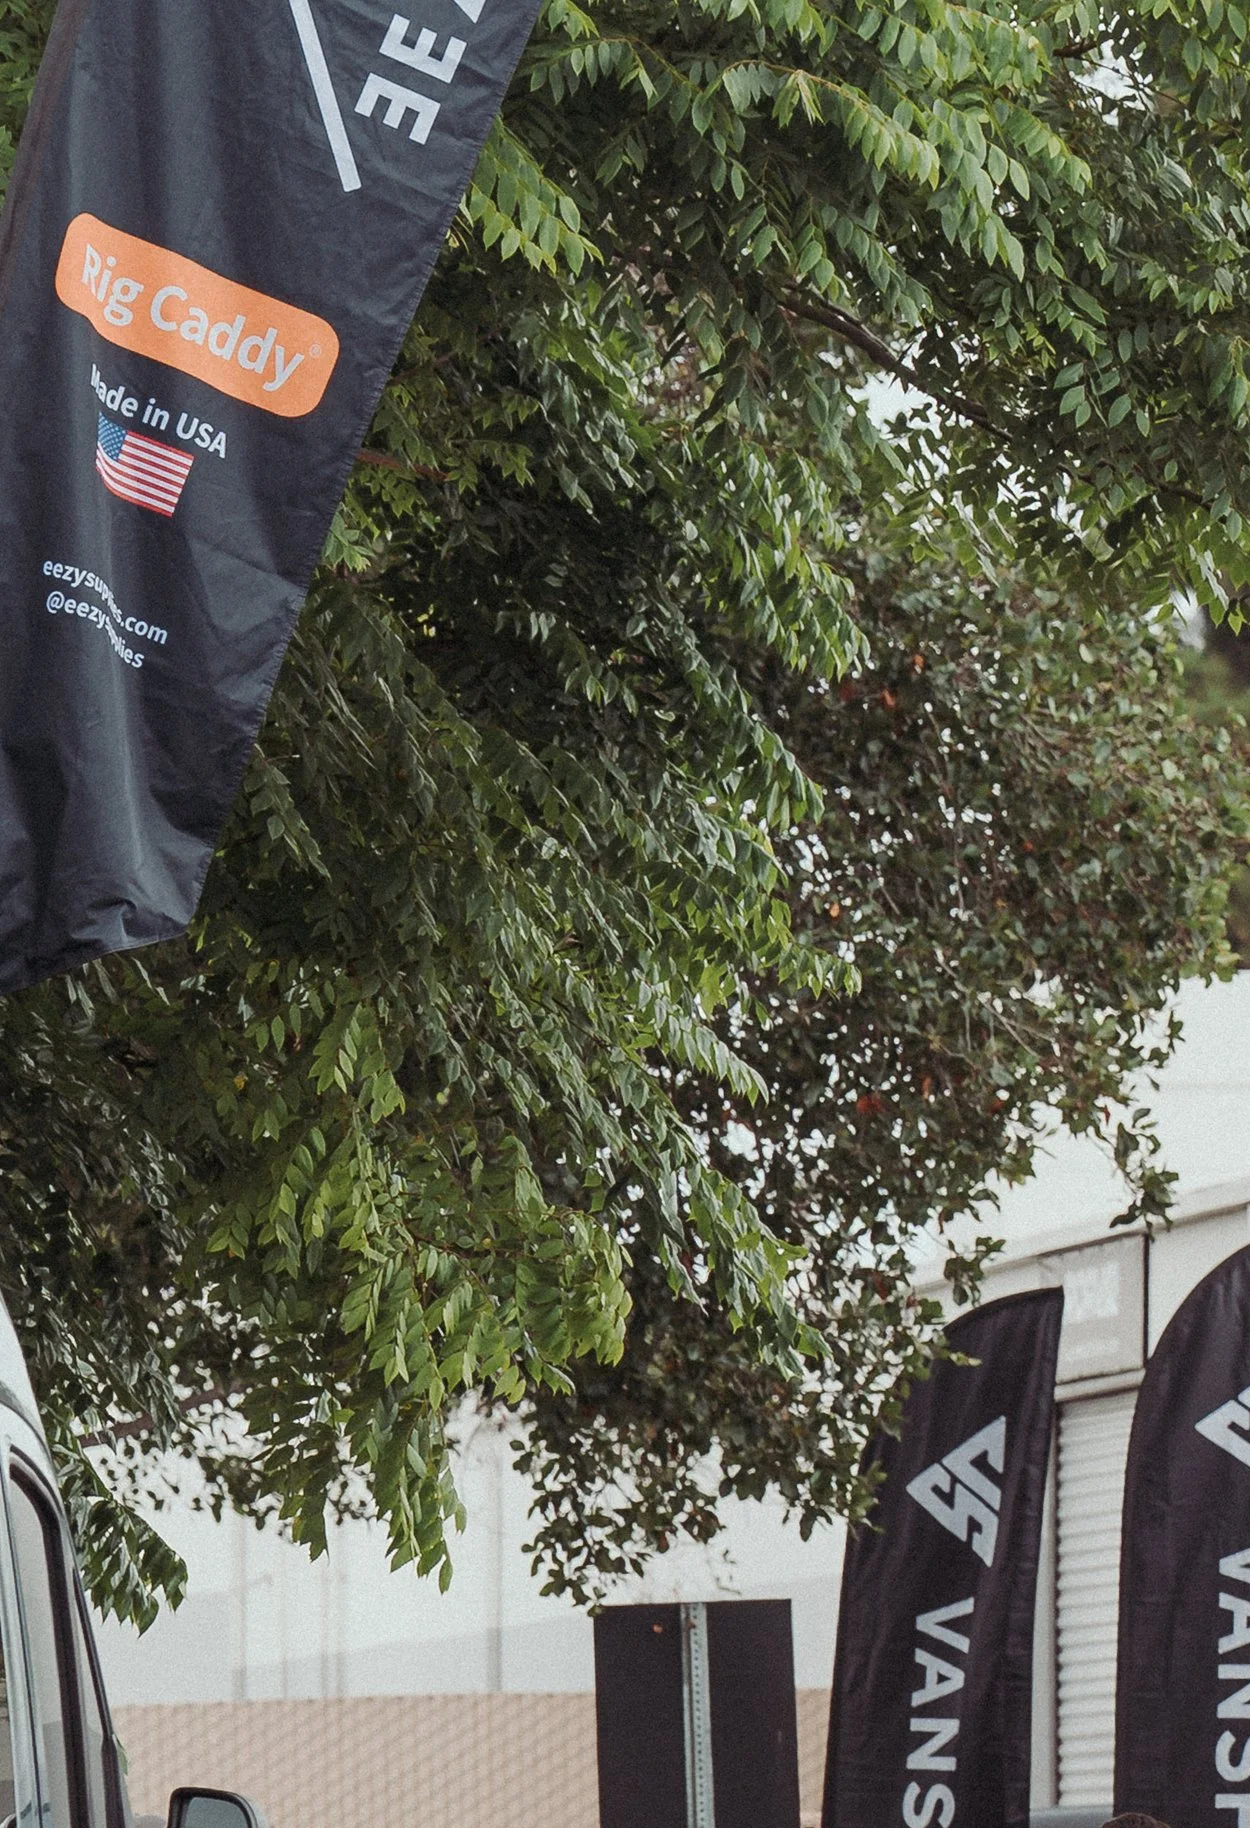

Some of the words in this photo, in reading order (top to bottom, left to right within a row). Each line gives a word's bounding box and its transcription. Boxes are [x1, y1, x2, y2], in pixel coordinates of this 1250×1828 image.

[81, 243, 145, 327] Rig
[149, 285, 304, 392] Caddy
[90, 363, 139, 418] Made
[142, 397, 170, 431] in
[175, 411, 227, 459] USA
